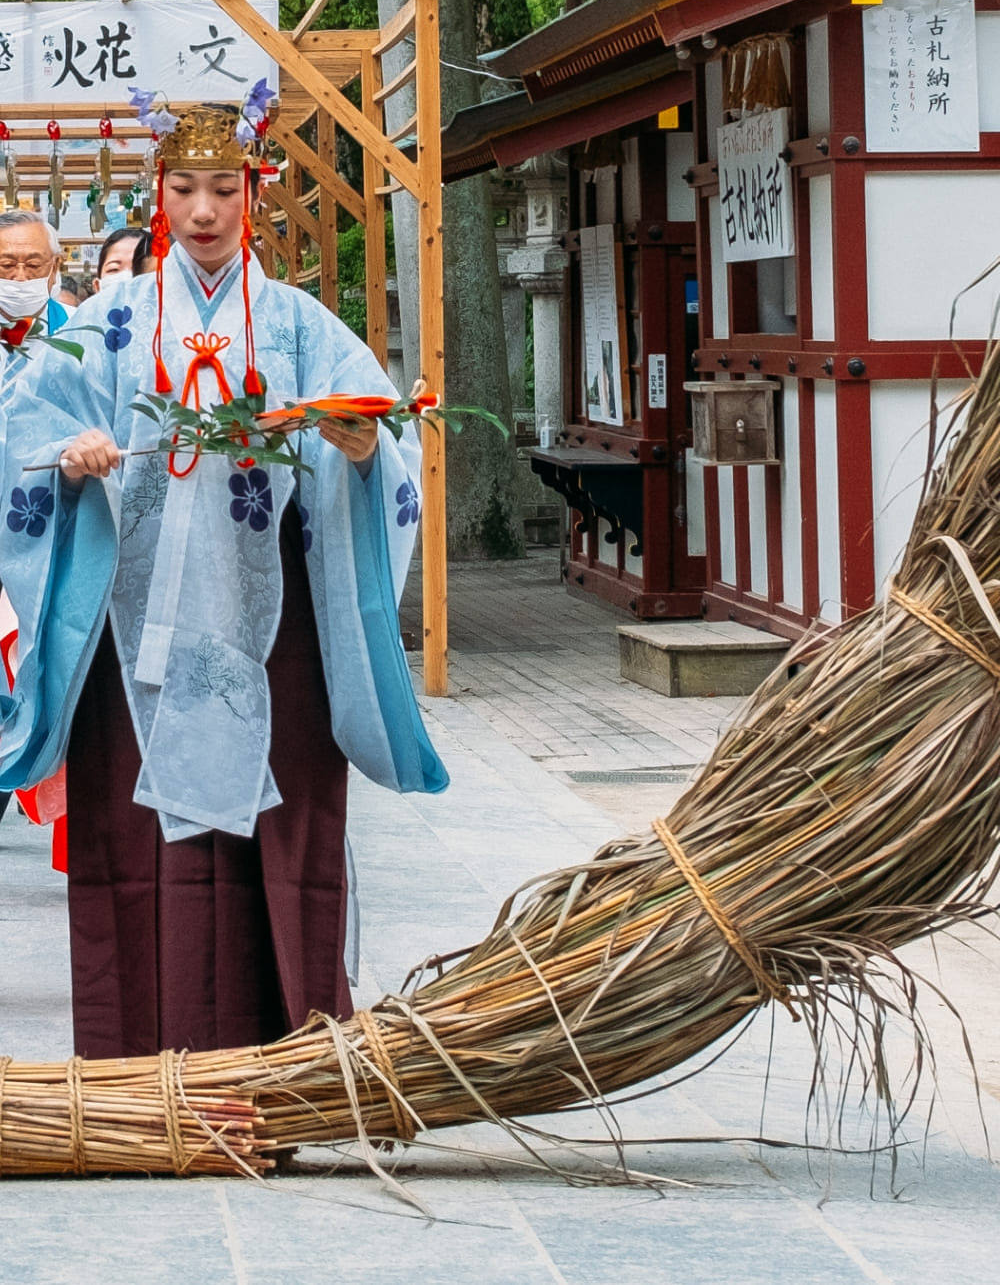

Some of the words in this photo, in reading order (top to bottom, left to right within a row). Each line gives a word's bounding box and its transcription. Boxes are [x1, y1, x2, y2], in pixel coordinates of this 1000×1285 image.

[904, 13, 916, 112] 古くなったおまもり
[926, 15, 950, 116] 古札納所
[720, 158, 783, 248] 古札納所
